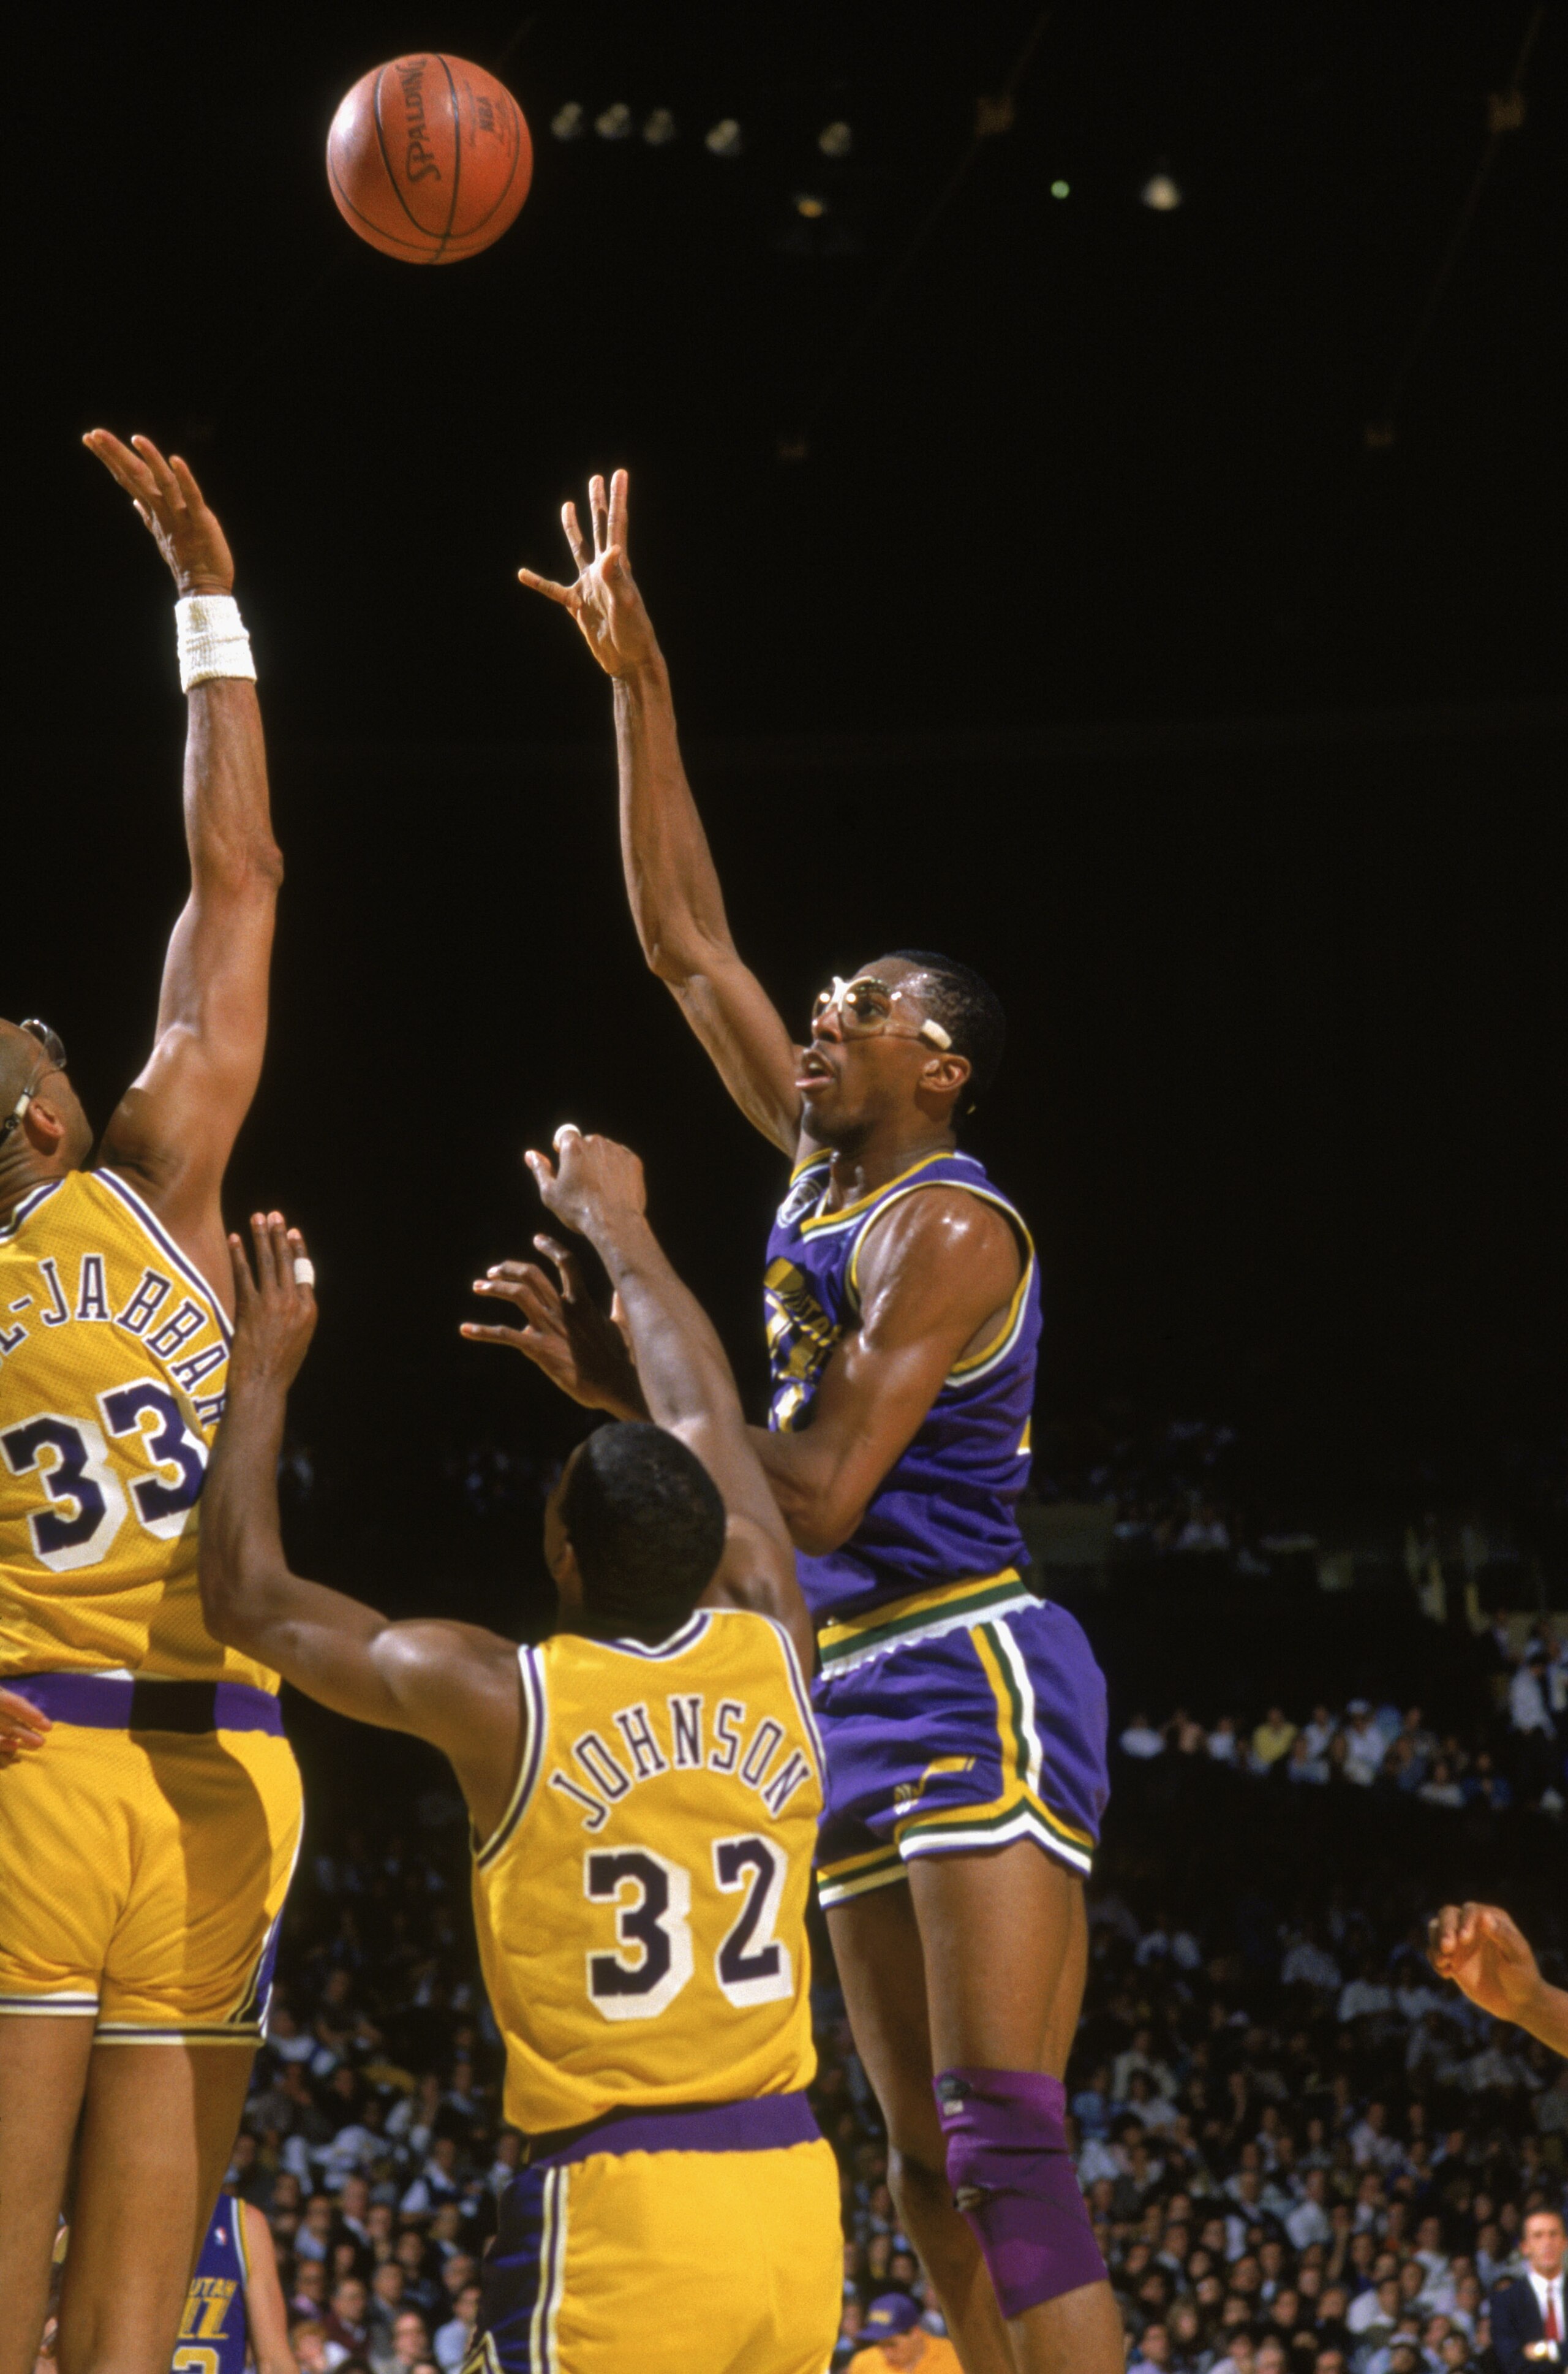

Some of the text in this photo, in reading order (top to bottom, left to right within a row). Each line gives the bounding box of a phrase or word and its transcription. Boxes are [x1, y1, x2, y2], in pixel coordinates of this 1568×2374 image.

[395, 58, 442, 184] SPALDING
[0, 1376, 210, 1573] 33
[548, 1694, 812, 1833] JOHNSON
[583, 1832, 794, 2021] 32
